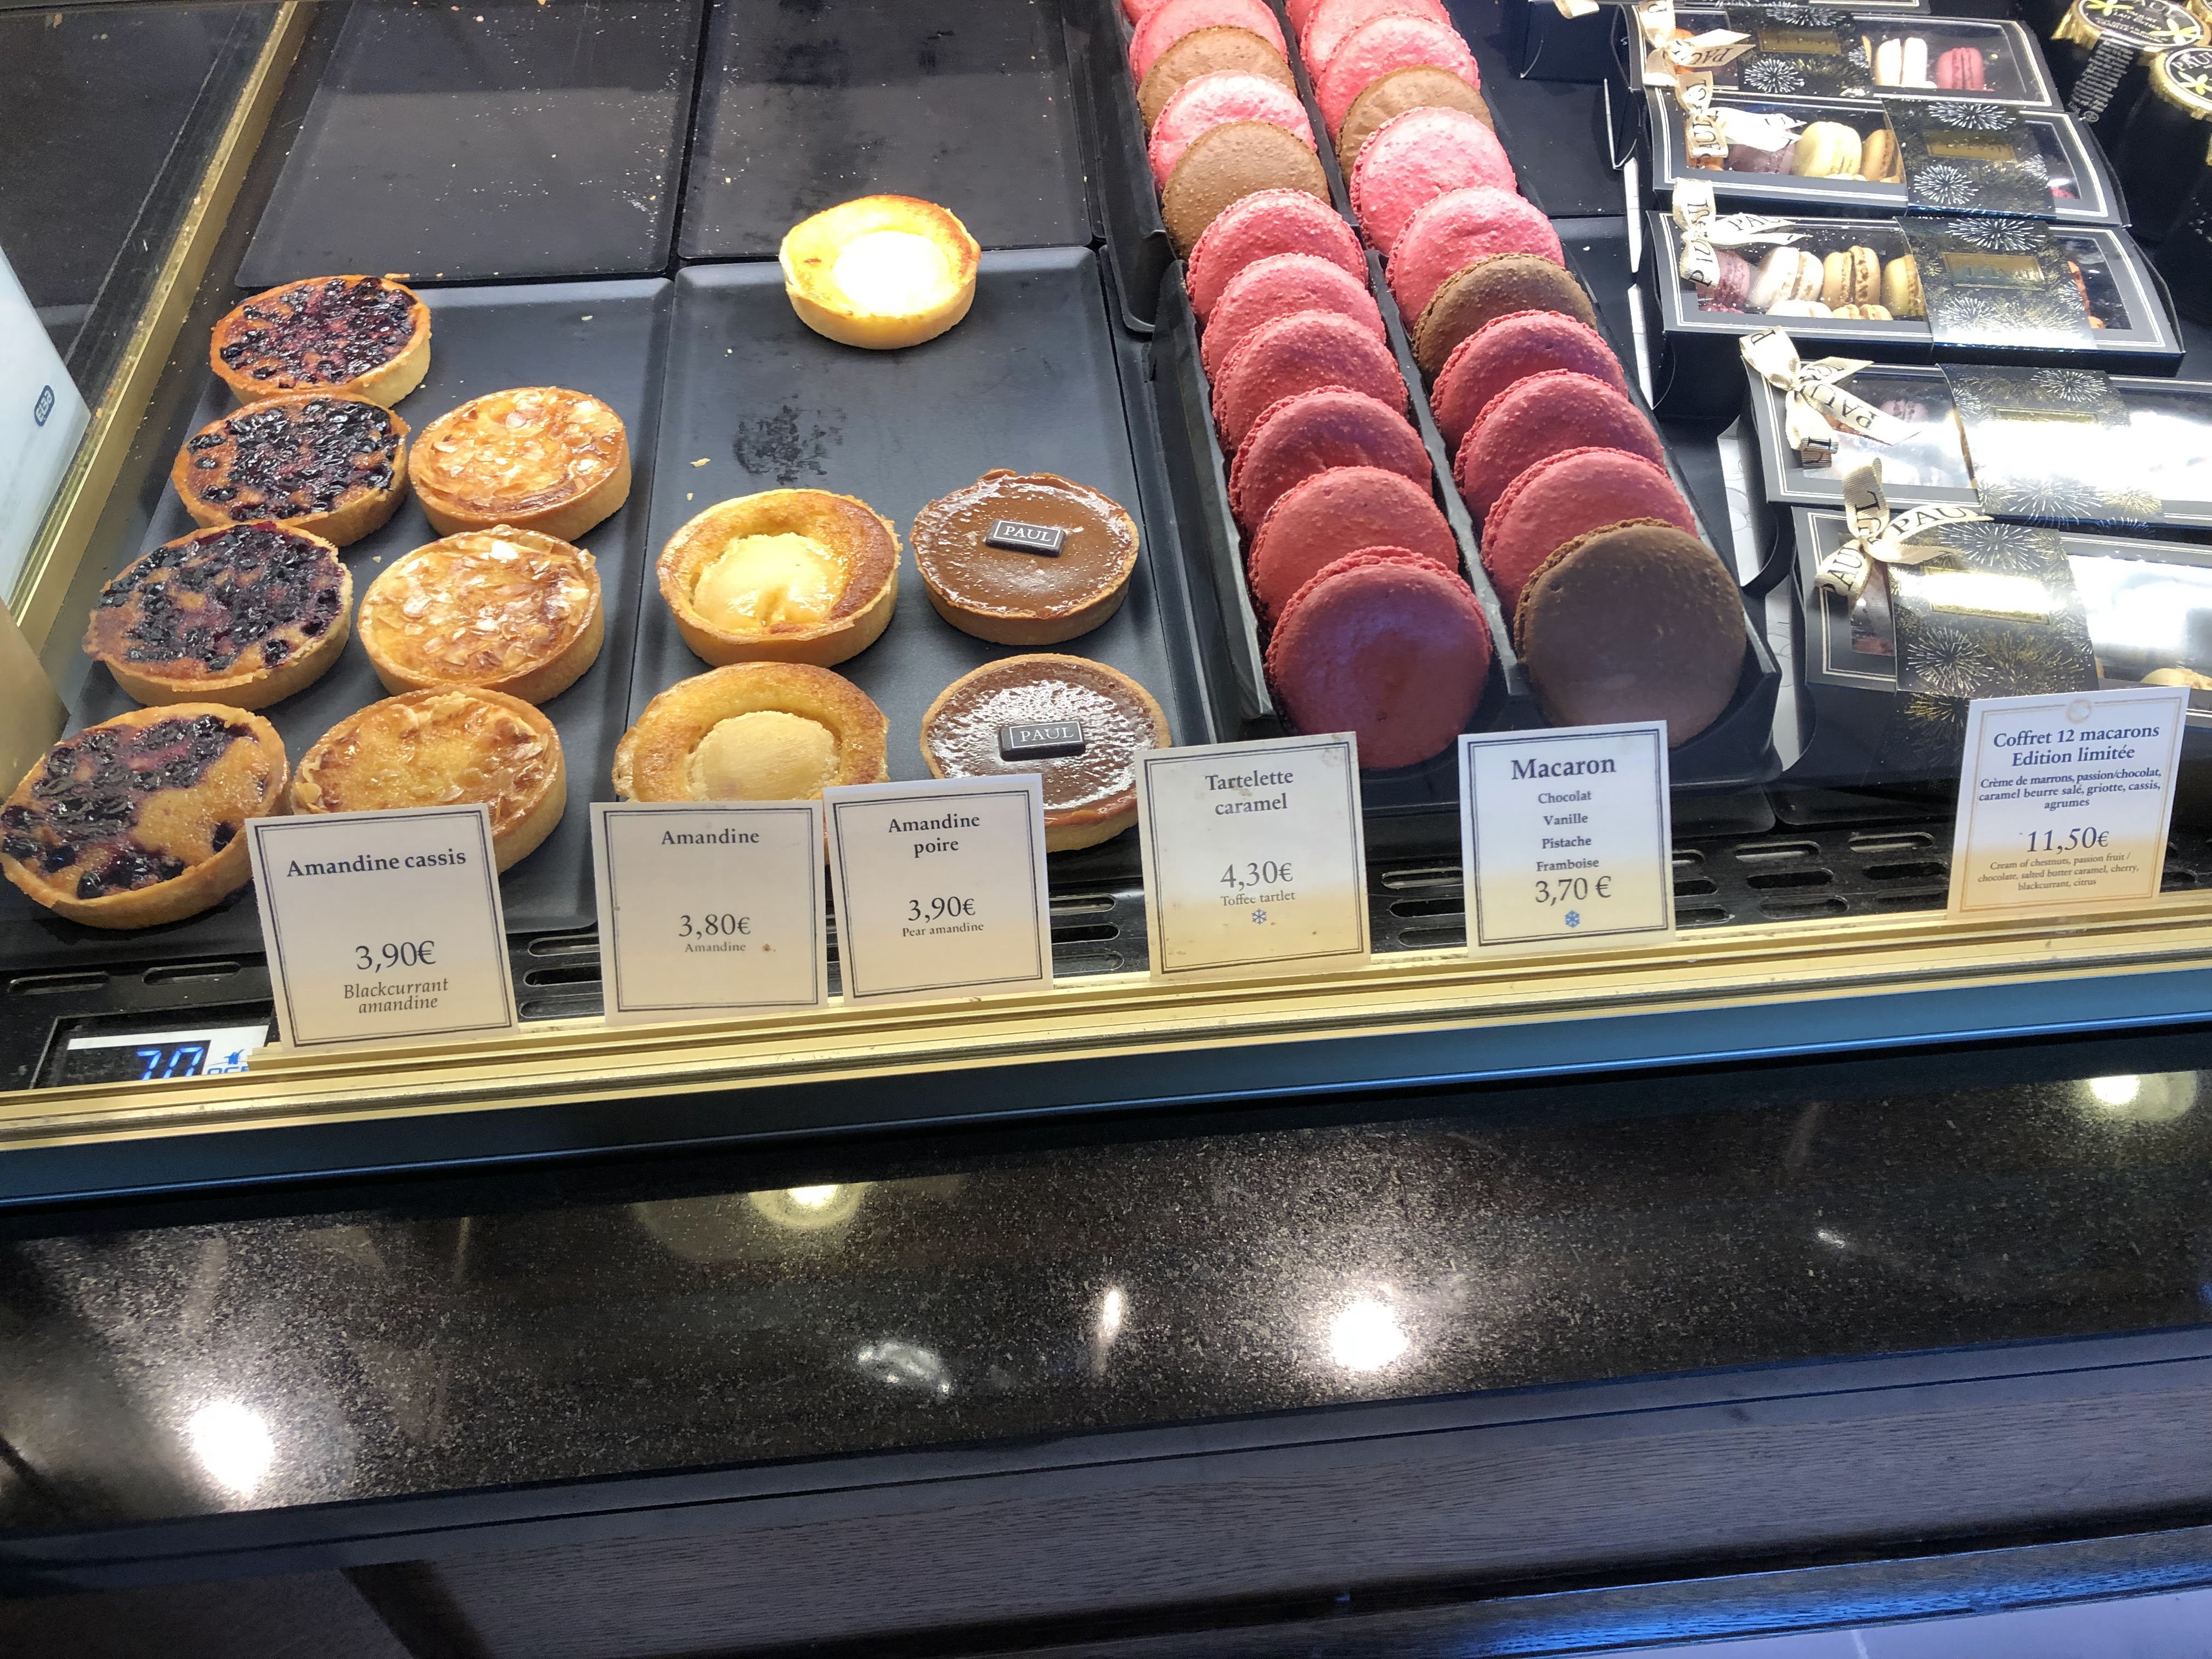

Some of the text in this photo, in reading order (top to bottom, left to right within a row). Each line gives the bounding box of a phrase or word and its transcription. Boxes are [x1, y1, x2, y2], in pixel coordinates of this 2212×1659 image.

[1003, 525, 1053, 542] PAUL
[1020, 727, 1074, 742] PAUL
[1994, 727, 2159, 747] Coffret 12 macarons
[2012, 744, 2135, 766] Edition limitée
[1511, 759, 1616, 780] Macaron
[1205, 770, 1293, 791] Tartelette
[1980, 778, 2013, 788] Crème
[2016, 776, 2028, 785] de
[2030, 775, 2074, 785] marrons,
[1538, 791, 1592, 804] Chocolat
[1979, 781, 2160, 801] caramel beurre salé, griotte, cassis,
[1215, 793, 1288, 815] caramel
[2044, 799, 2089, 811] agrumes
[889, 814, 980, 832] Amandine
[1543, 813, 1588, 825] Vanille
[662, 828, 759, 844] Amandine
[1542, 836, 1592, 849] Pistache
[2027, 827, 2111, 855] 11,50€
[914, 838, 958, 858] poire
[287, 848, 466, 877] Amandine cassis
[1536, 858, 1599, 871] Framboise
[2019, 859, 2029, 867] of
[2073, 856, 2103, 866] passion
[1220, 861, 1293, 891] 4,30€
[1221, 890, 1295, 906] Toffee tartlet
[1536, 876, 1611, 906] 3,70 €
[909, 896, 975, 924] 3,90€
[679, 914, 751, 939] 3,80€
[903, 923, 984, 936] Pear amandine
[685, 942, 746, 952] Amandine
[356, 941, 436, 973] 3,90€
[344, 978, 448, 999] Blackcurrant
[359, 995, 437, 1013] amandine
